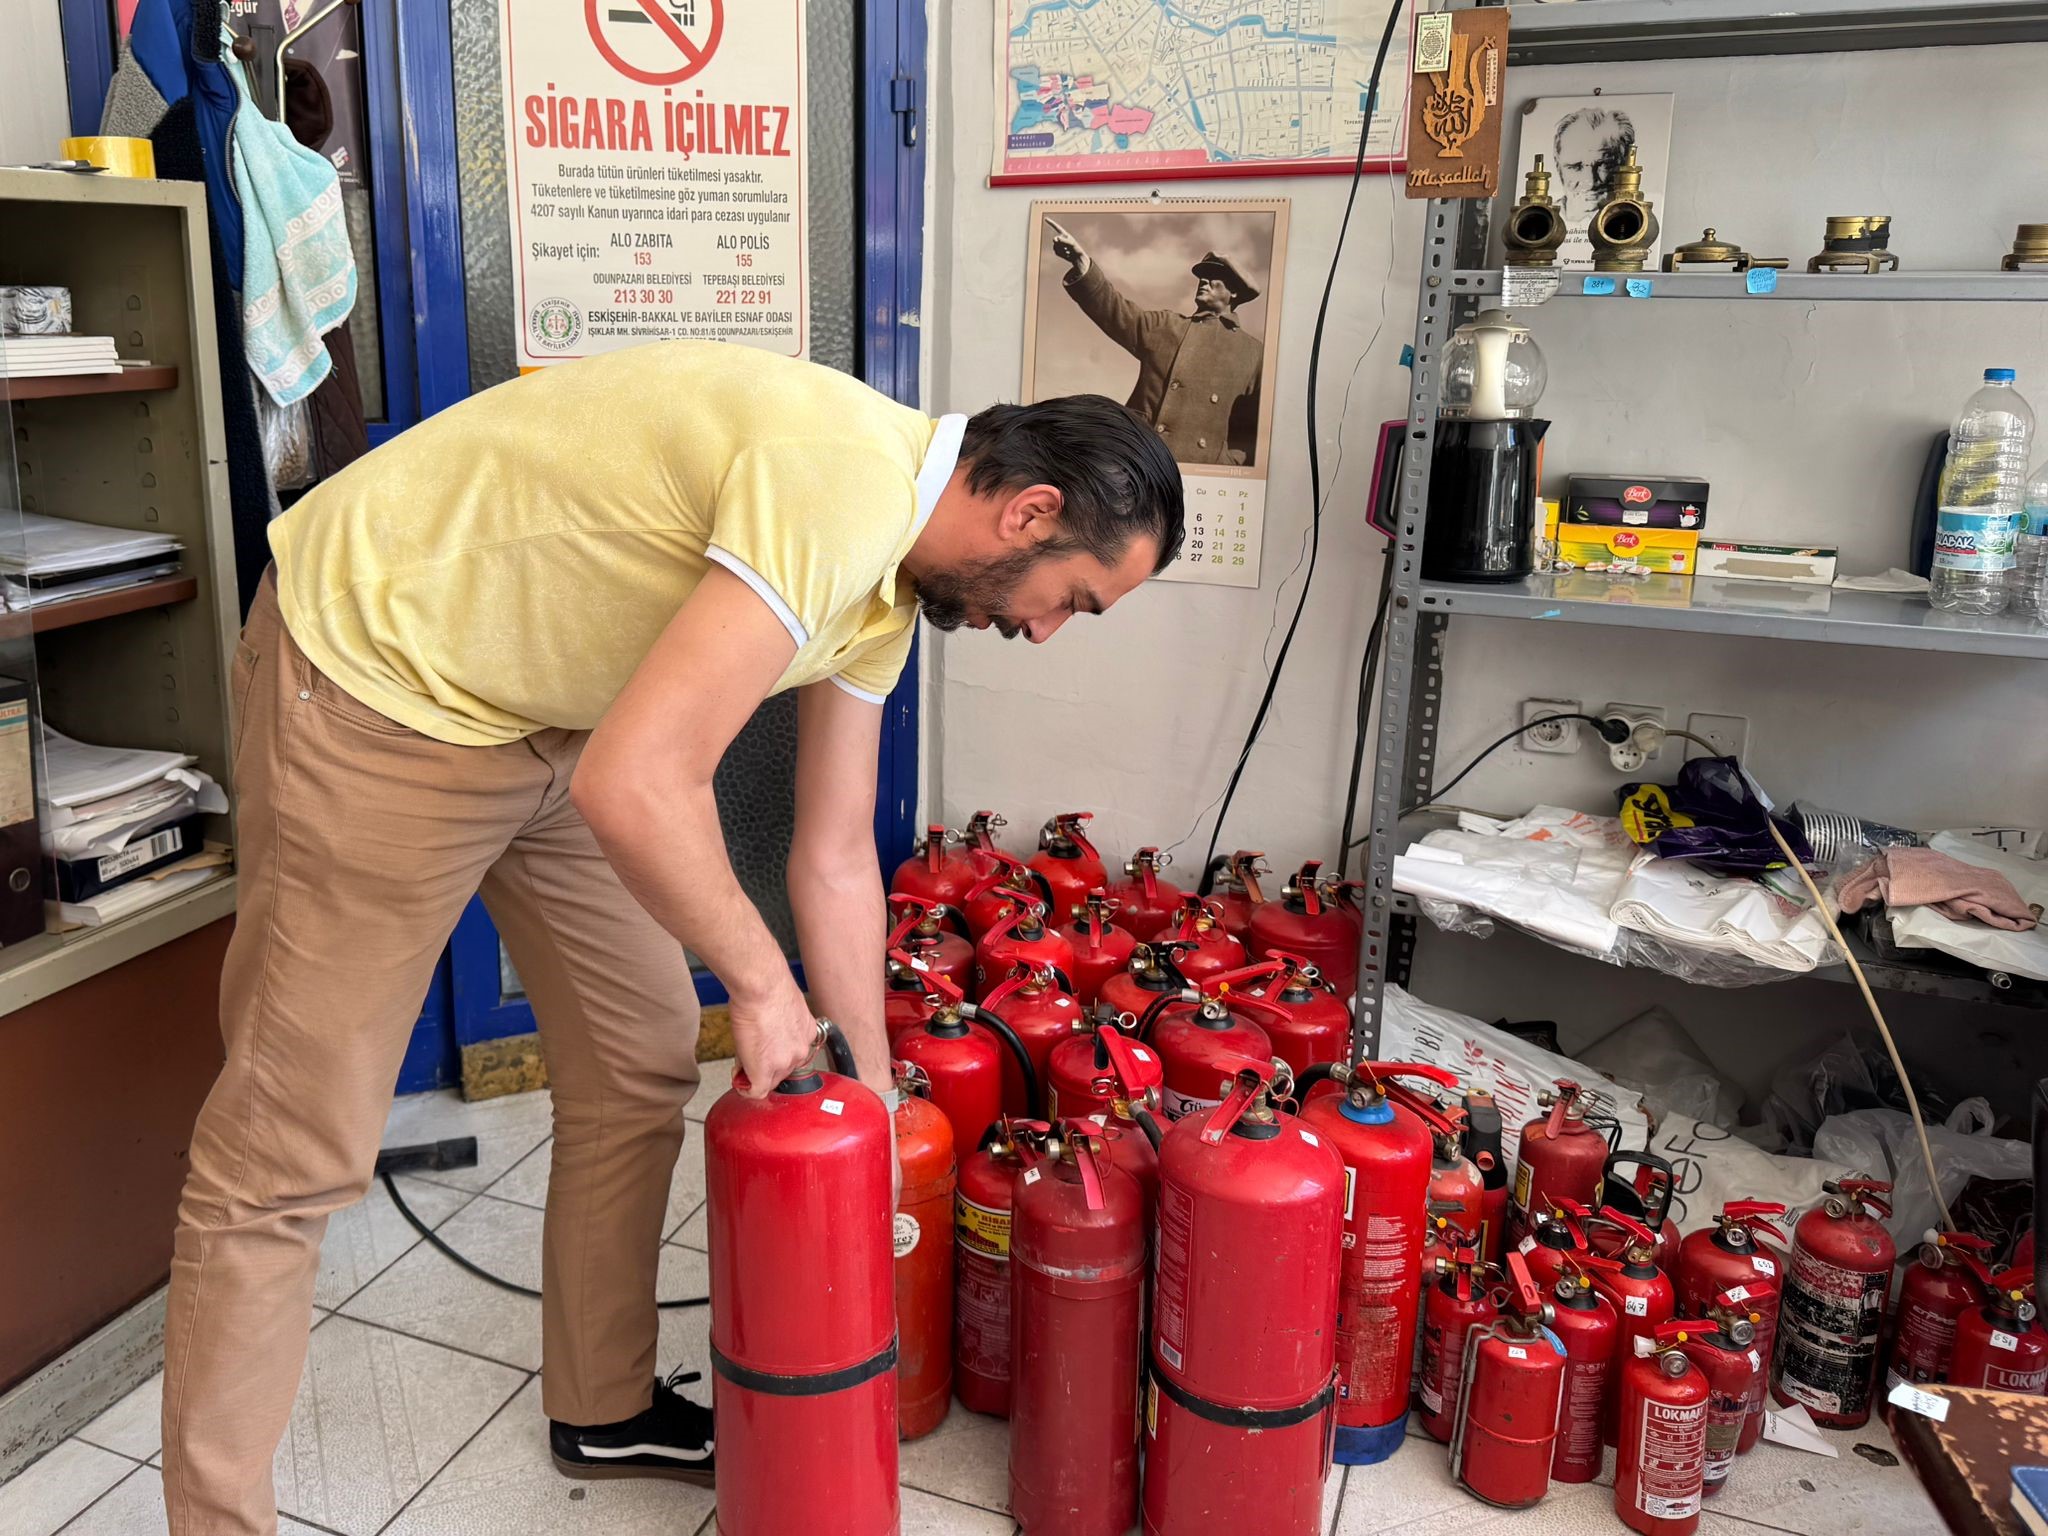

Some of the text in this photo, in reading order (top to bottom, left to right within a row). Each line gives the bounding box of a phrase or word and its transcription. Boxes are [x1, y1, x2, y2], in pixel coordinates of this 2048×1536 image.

[524, 82, 792, 162] SİGARA İÇİLMEZ
[558, 163, 763, 185] Burada tütün ürünleri tüketilmesi yasaktır.
[532, 183, 788, 205] Tüketenlere ve tüketilmesine göz yuman sorumlulara
[530, 204, 791, 225] 4207 sayılı Kanun uyarınca idari para cezası uygulanır
[610, 233, 673, 249] ALO ZABITA
[717, 232, 770, 250] ALO POLİS
[532, 242, 600, 262] Şikayet için:
[634, 252, 652, 266] 153
[735, 253, 753, 267] 155
[593, 271, 692, 286] ODUNPAZARI BELEDİYESİ
[703, 272, 785, 288] TEPEBAŞI BELEDİYESİ
[614, 289, 673, 304] 213 30 30
[716, 290, 772, 304] 221 22 91
[588, 309, 793, 325] ESKİŞEHİR-BAKKAL VE BAYİLER ESNAF ODASI
[717, 325, 794, 337] ODUNPAZARI/ESKİŞEHİR
[1196, 488, 1207, 496] Cu
[1218, 489, 1227, 497] Ct
[1240, 502, 1245, 511] 1
[1196, 513, 1244, 525] 6 7 8
[1193, 527, 1247, 539] 13 14 15
[1191, 540, 1246, 552] 20 21 22
[1190, 553, 1203, 562] 27
[1211, 555, 1223, 564] 28
[1232, 556, 1245, 566] 29
[1626, 1301, 1645, 1312] 647
